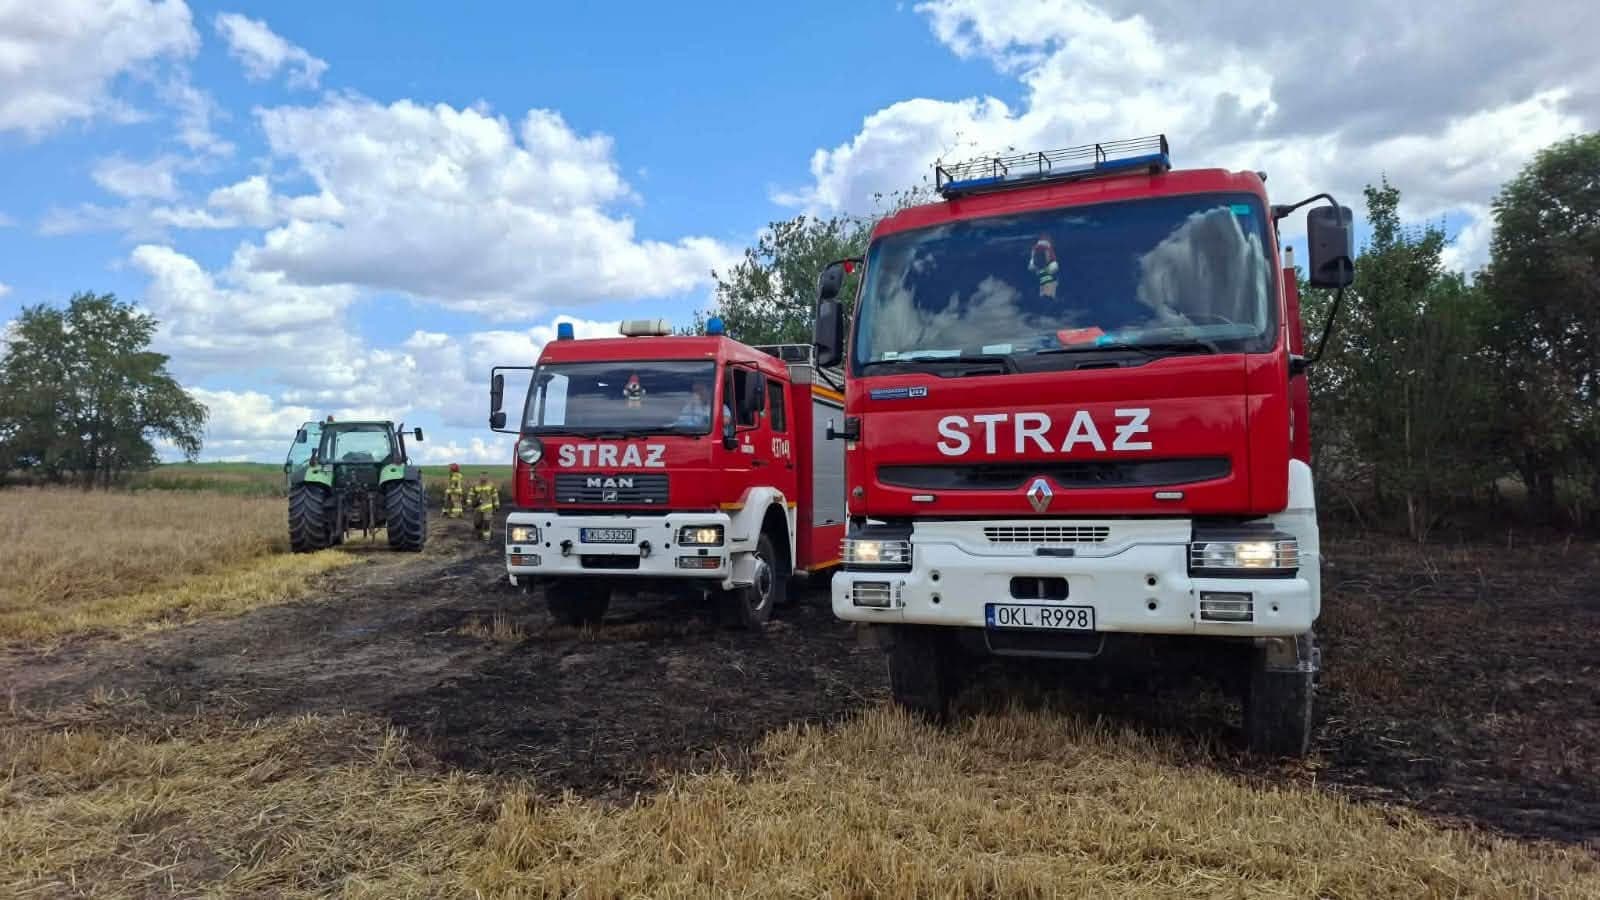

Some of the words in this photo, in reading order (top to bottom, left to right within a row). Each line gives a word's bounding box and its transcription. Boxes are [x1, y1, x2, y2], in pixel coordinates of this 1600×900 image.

[586, 478, 634, 488] MAN
[999, 607, 1033, 626] OKL
[1040, 608, 1088, 628] R998
